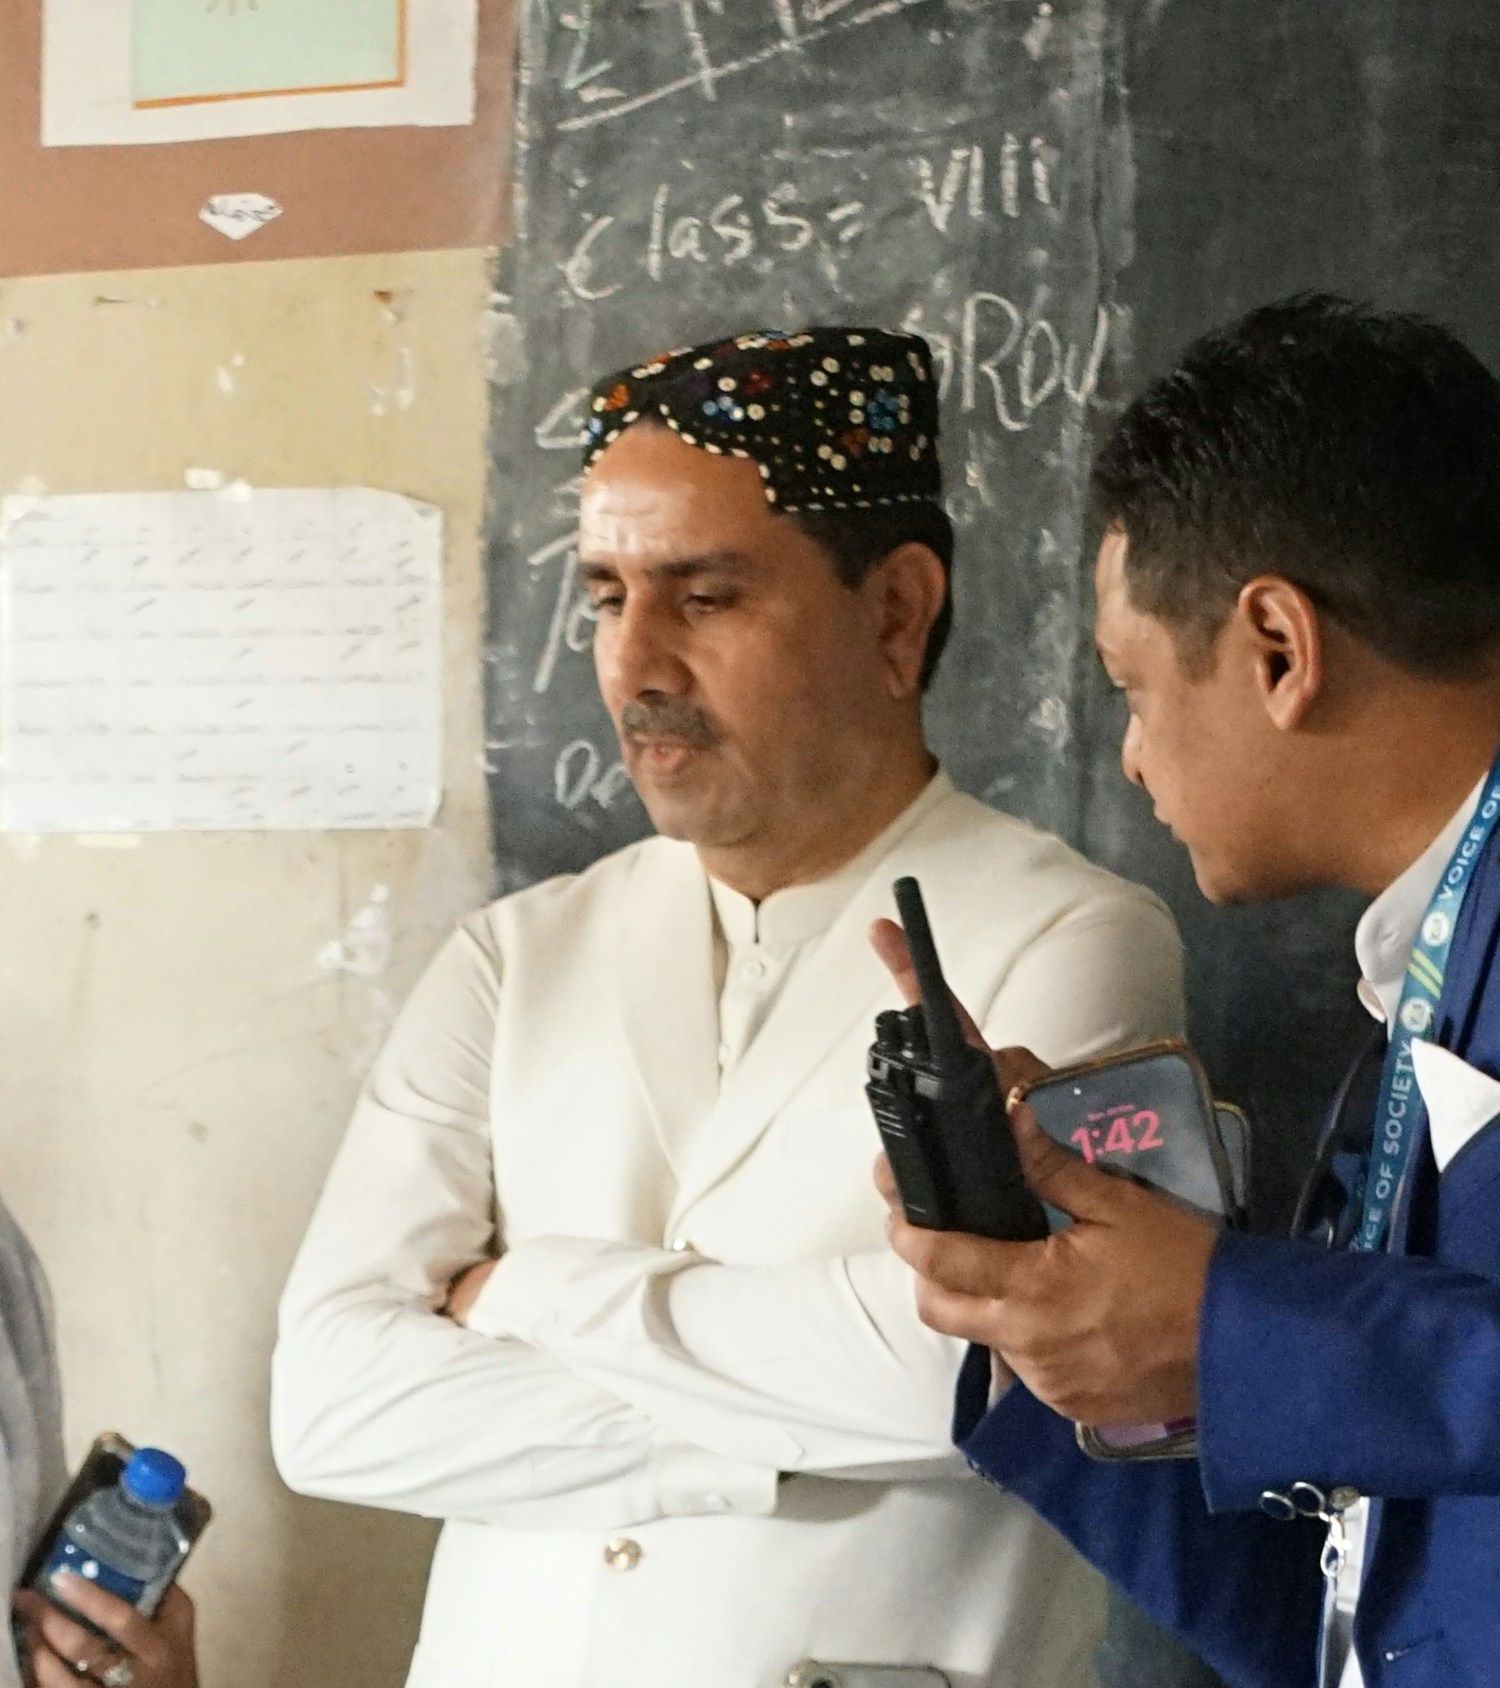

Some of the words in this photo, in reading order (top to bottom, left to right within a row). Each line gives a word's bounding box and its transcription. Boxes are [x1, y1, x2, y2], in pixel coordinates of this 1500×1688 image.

[1438, 826, 1486, 900] VOICE
[1383, 1040, 1415, 1156] SOCIETY
[1071, 1109, 1165, 1166] 1:42
[1375, 1160, 1393, 1200] OF
